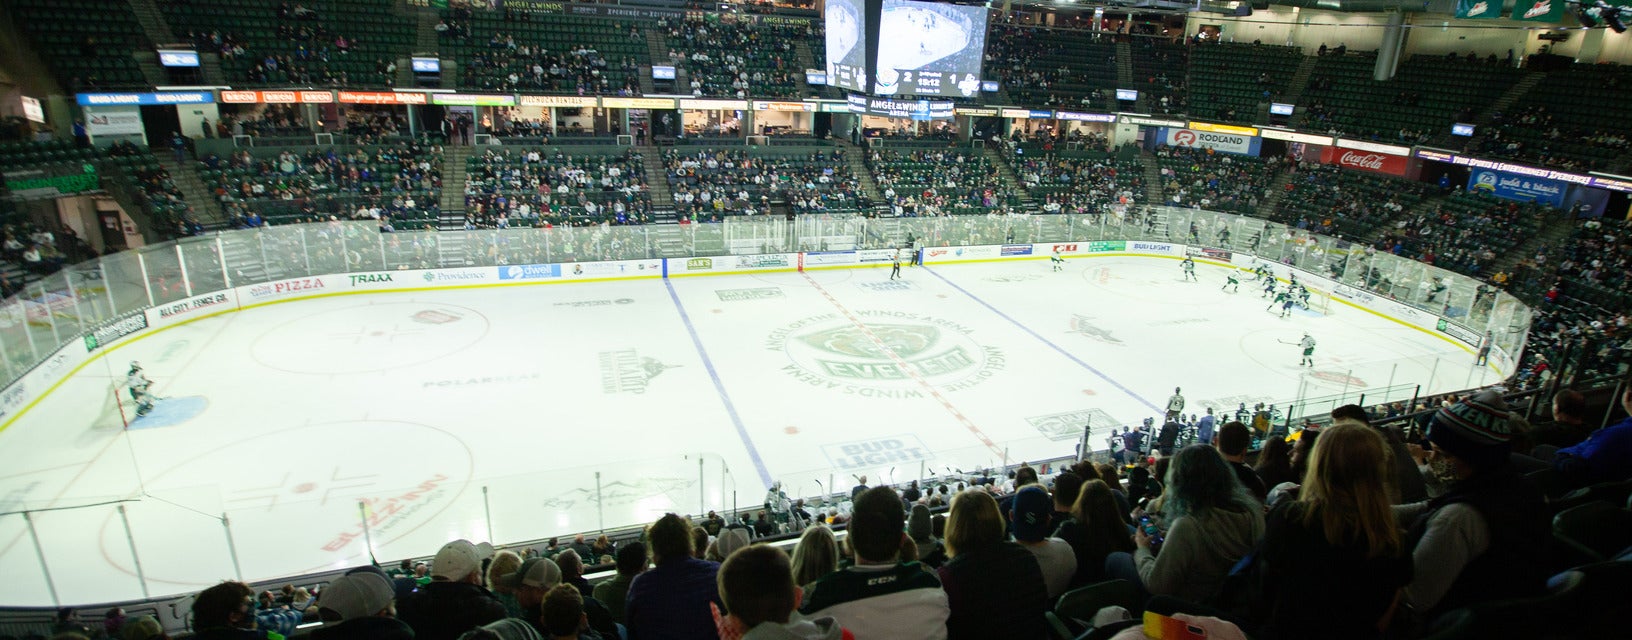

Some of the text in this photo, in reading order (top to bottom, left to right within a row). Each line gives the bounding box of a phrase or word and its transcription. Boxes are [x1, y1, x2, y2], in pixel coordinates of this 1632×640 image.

[903, 71, 912, 82] 2
[949, 74, 956, 84] 1
[1199, 134, 1243, 145] RODLAND
[1481, 173, 1494, 182] 75
[348, 273, 393, 287] TRAXX
[437, 271, 486, 281] Providence
[274, 278, 325, 293] PIZZA
[856, 309, 919, 319] WINDS
[921, 316, 975, 334] ARENA
[781, 364, 841, 389] ARENA
[843, 384, 924, 399] WINDS
[842, 439, 904, 456] BUD
[837, 447, 924, 469] LIGHT
